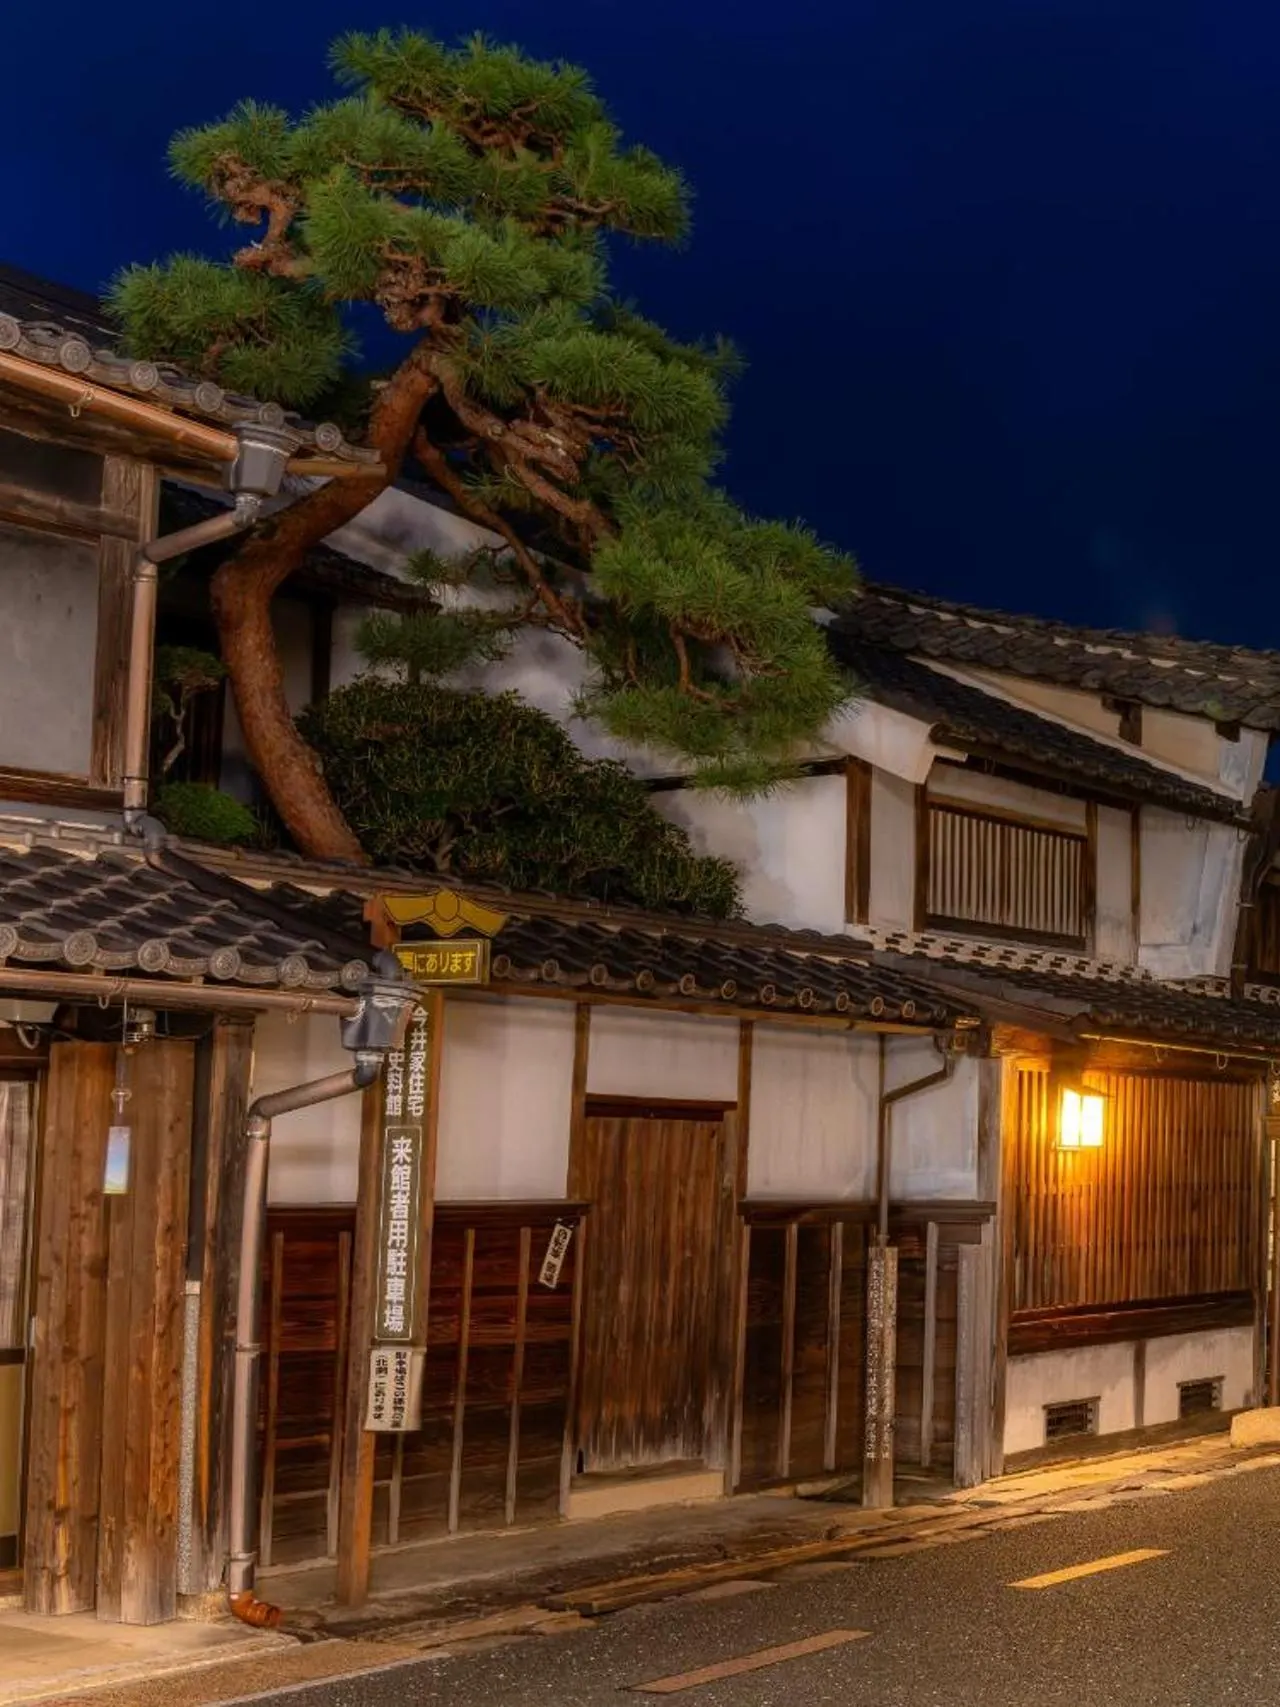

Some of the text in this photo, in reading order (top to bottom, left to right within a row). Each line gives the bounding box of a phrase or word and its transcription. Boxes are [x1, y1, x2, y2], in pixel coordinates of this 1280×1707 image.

[408, 1006, 429, 1117] 今井家住宅
[384, 1136, 412, 1332] 来館者用駐車場
